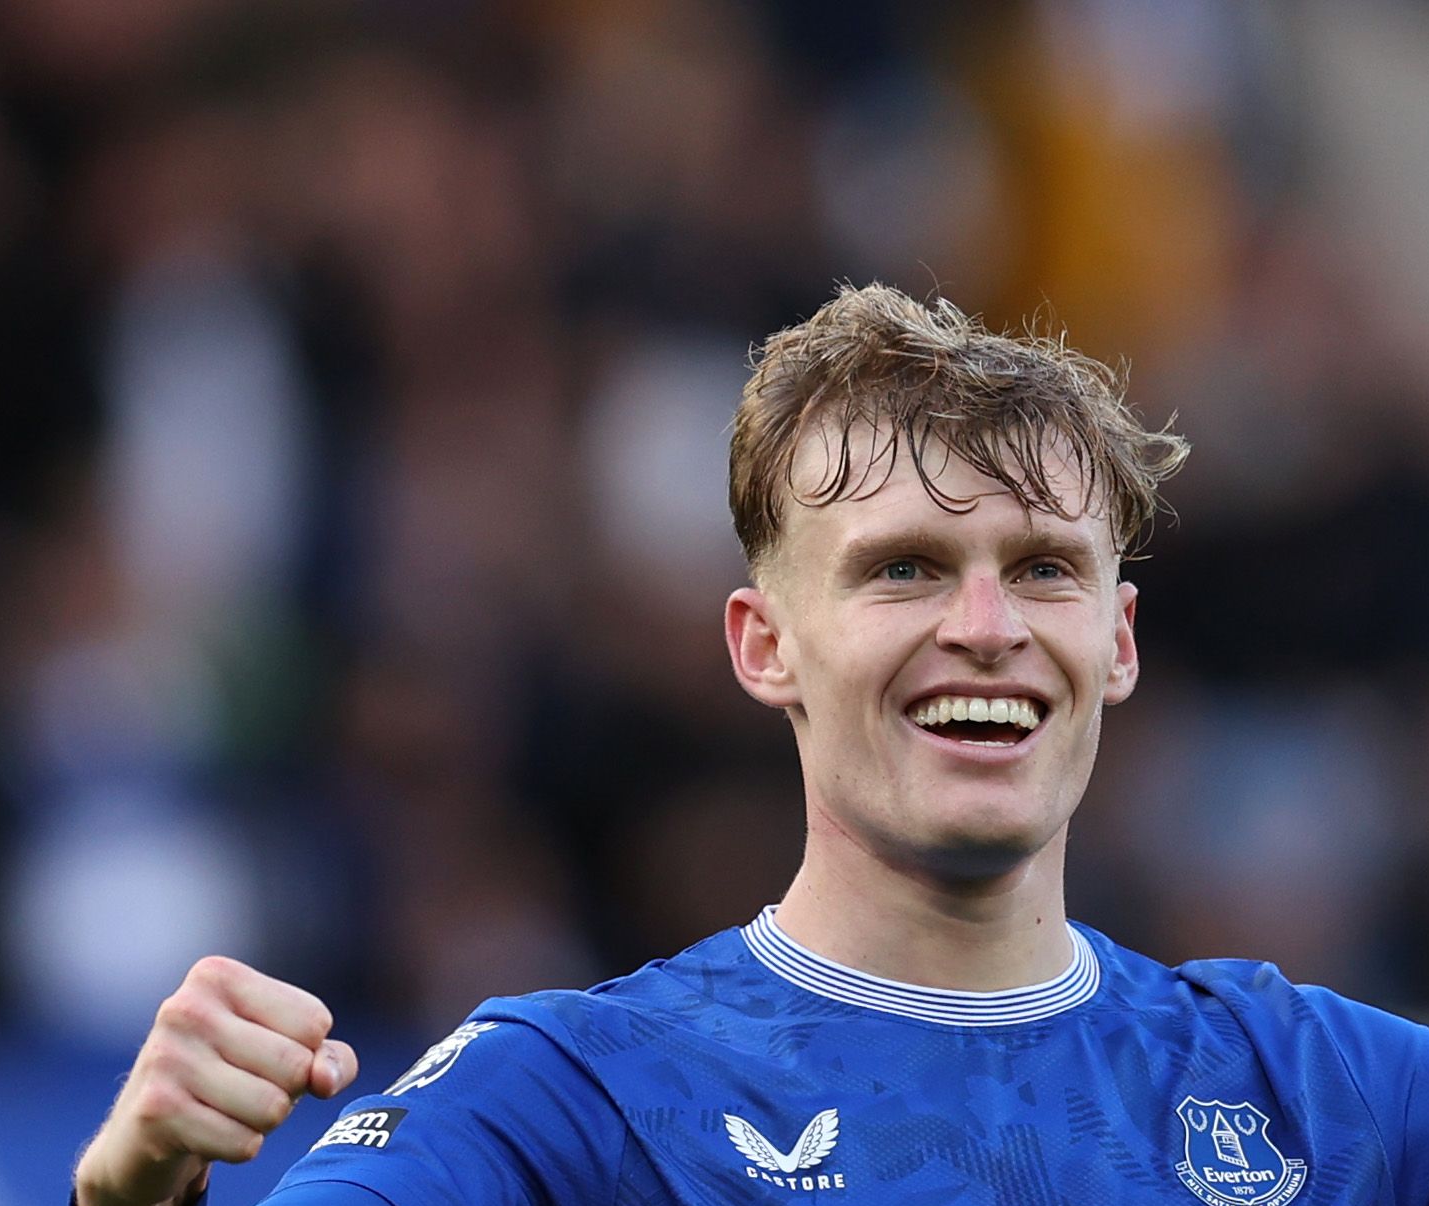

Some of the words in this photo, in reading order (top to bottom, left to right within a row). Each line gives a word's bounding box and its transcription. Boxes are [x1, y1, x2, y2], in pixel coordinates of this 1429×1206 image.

[1202, 1166, 1276, 1183] Everton
[1186, 1178, 1203, 1196] NIL
[1232, 1185, 1256, 1196] 1878
